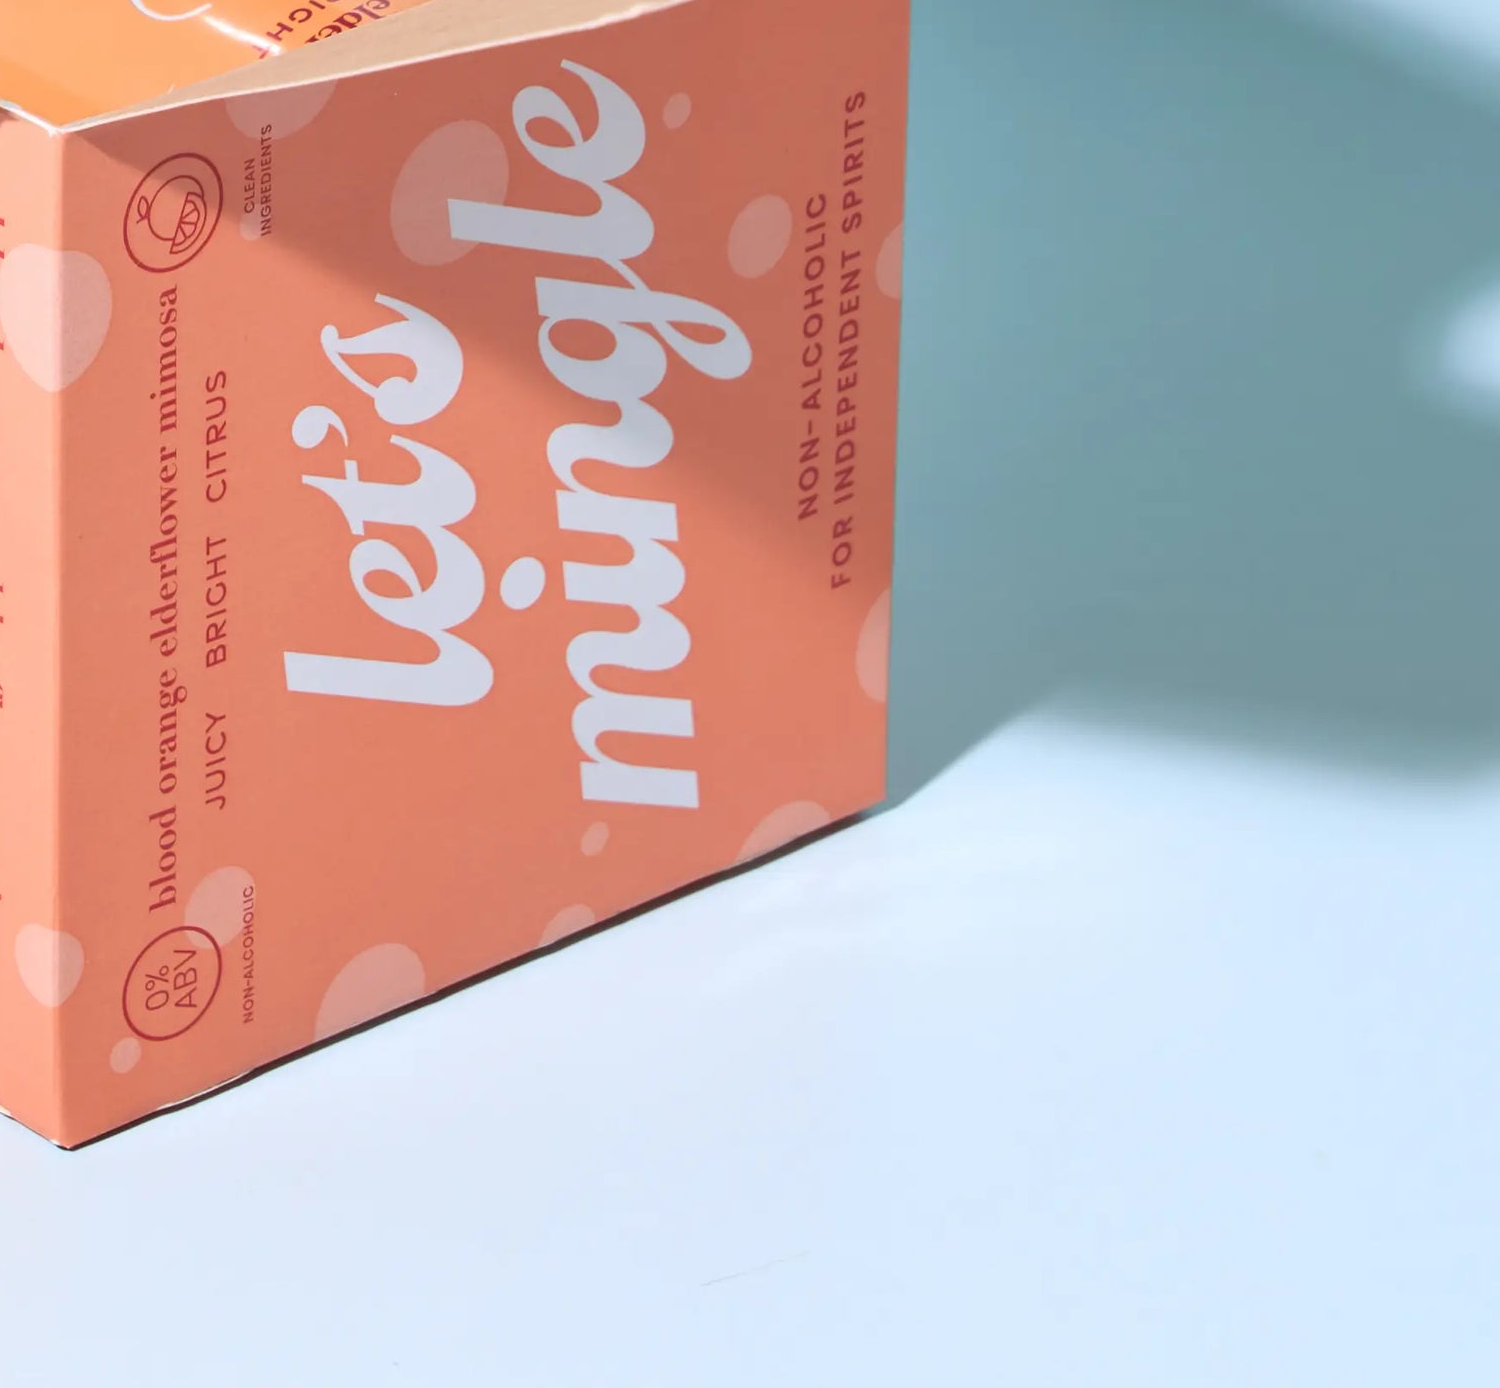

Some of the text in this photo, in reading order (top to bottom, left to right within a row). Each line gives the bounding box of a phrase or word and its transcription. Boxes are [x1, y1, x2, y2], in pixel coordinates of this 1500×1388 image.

[244, 157, 256, 214] CLEAN
[261, 123, 272, 237] INGREDIENTS
[447, 58, 753, 809] mingle
[798, 191, 827, 521] NON-ALCOHOLIC
[831, 89, 867, 589] FOR INDEPENDENT SPIRITS
[149, 284, 187, 913] blood orange elderflower mimosa
[205, 370, 228, 810] JUICY BRIGHT CITRUS
[145, 965, 170, 1011] 0%
[173, 949, 197, 1009] ABV
[243, 885, 254, 1023] NON-ALCOHOLIC
